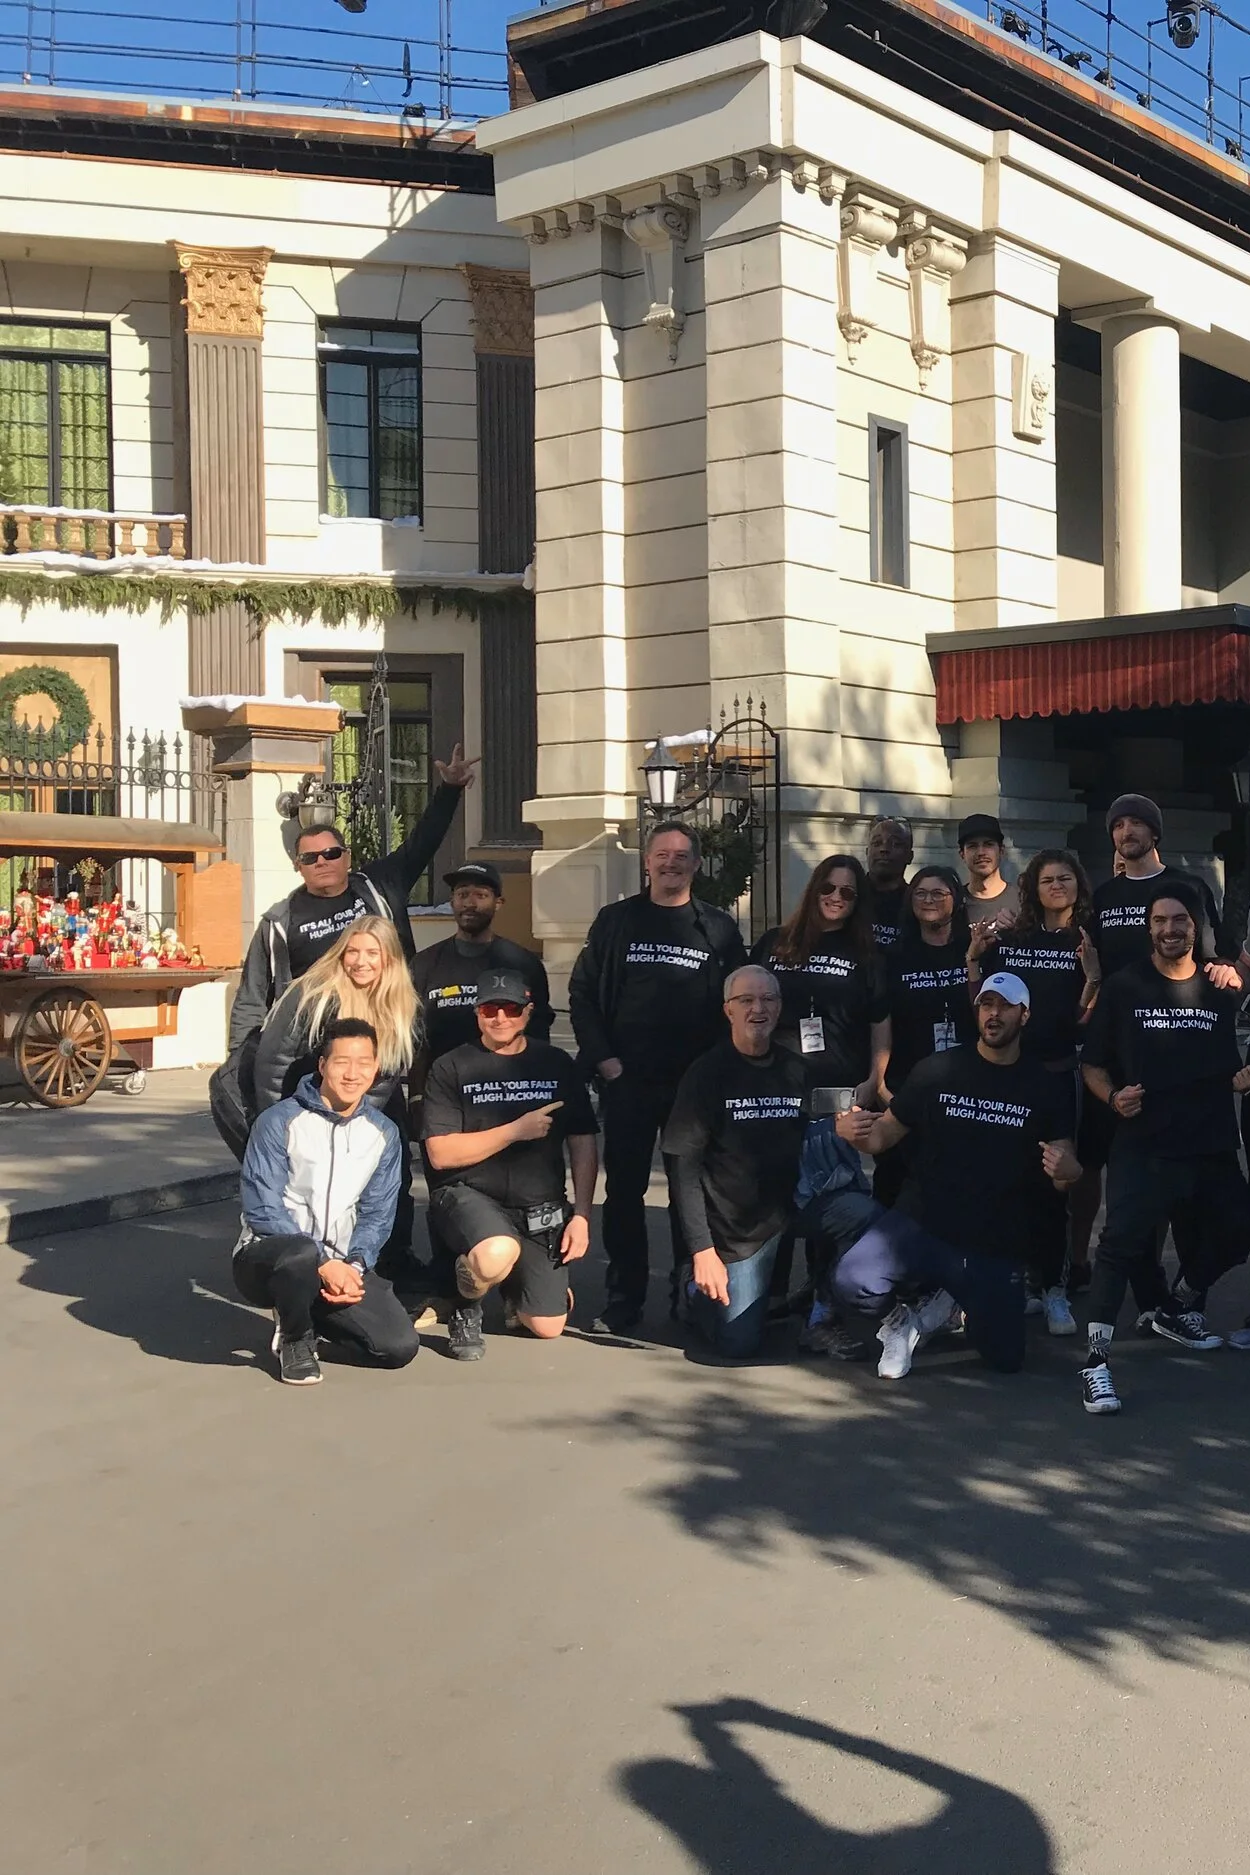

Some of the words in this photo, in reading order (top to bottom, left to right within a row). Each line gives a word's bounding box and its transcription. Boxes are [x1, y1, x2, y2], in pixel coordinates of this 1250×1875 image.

[1110, 907, 1123, 916] ALL
[300, 921, 317, 933] IT'S
[1102, 918, 1123, 928] HUGH
[309, 924, 335, 940] HUGH
[636, 943, 655, 952] ALL
[656, 944, 682, 955] YOUR
[682, 947, 710, 961] FAULT
[999, 946, 1015, 956] IT'S
[1015, 948, 1032, 957] ALL
[1034, 949, 1058, 958] YOUR
[626, 954, 655, 962] HUGH
[655, 954, 701, 970] JACKMAN
[1005, 957, 1032, 968] HUGH
[1032, 959, 1076, 970] JACKMAN
[902, 972, 918, 981] IT'S
[919, 971, 935, 979] ALL
[909, 980, 937, 989] HUGH
[437, 997, 462, 1009] HUGH
[1134, 1008, 1151, 1018] IT'S
[1152, 1008, 1169, 1017] ALL
[1169, 1008, 1195, 1017] YOUR
[1195, 1008, 1219, 1022] FAULT
[1143, 1019, 1170, 1029] HUGH
[1170, 1019, 1213, 1031] JACKMAN
[463, 1083, 481, 1094] IT'S
[483, 1081, 502, 1091] ALL
[502, 1080, 530, 1091] YOUR
[530, 1080, 558, 1089] FAULT
[472, 1092, 503, 1104] HUGH
[503, 1091, 552, 1101] JACKMAN
[725, 1098, 742, 1109] IT'S
[742, 1097, 758, 1108] ALL
[758, 1097, 782, 1106] YOUR
[939, 1093, 957, 1104] IT'S
[957, 1096, 976, 1107] ALL
[977, 1099, 1004, 1112] YOUR
[1005, 1103, 1031, 1117] FAUT
[733, 1109, 760, 1120] HUGH
[760, 1108, 799, 1118] JACKMAN
[945, 1106, 976, 1119] HUGH
[976, 1112, 1024, 1128] JACKMAN
